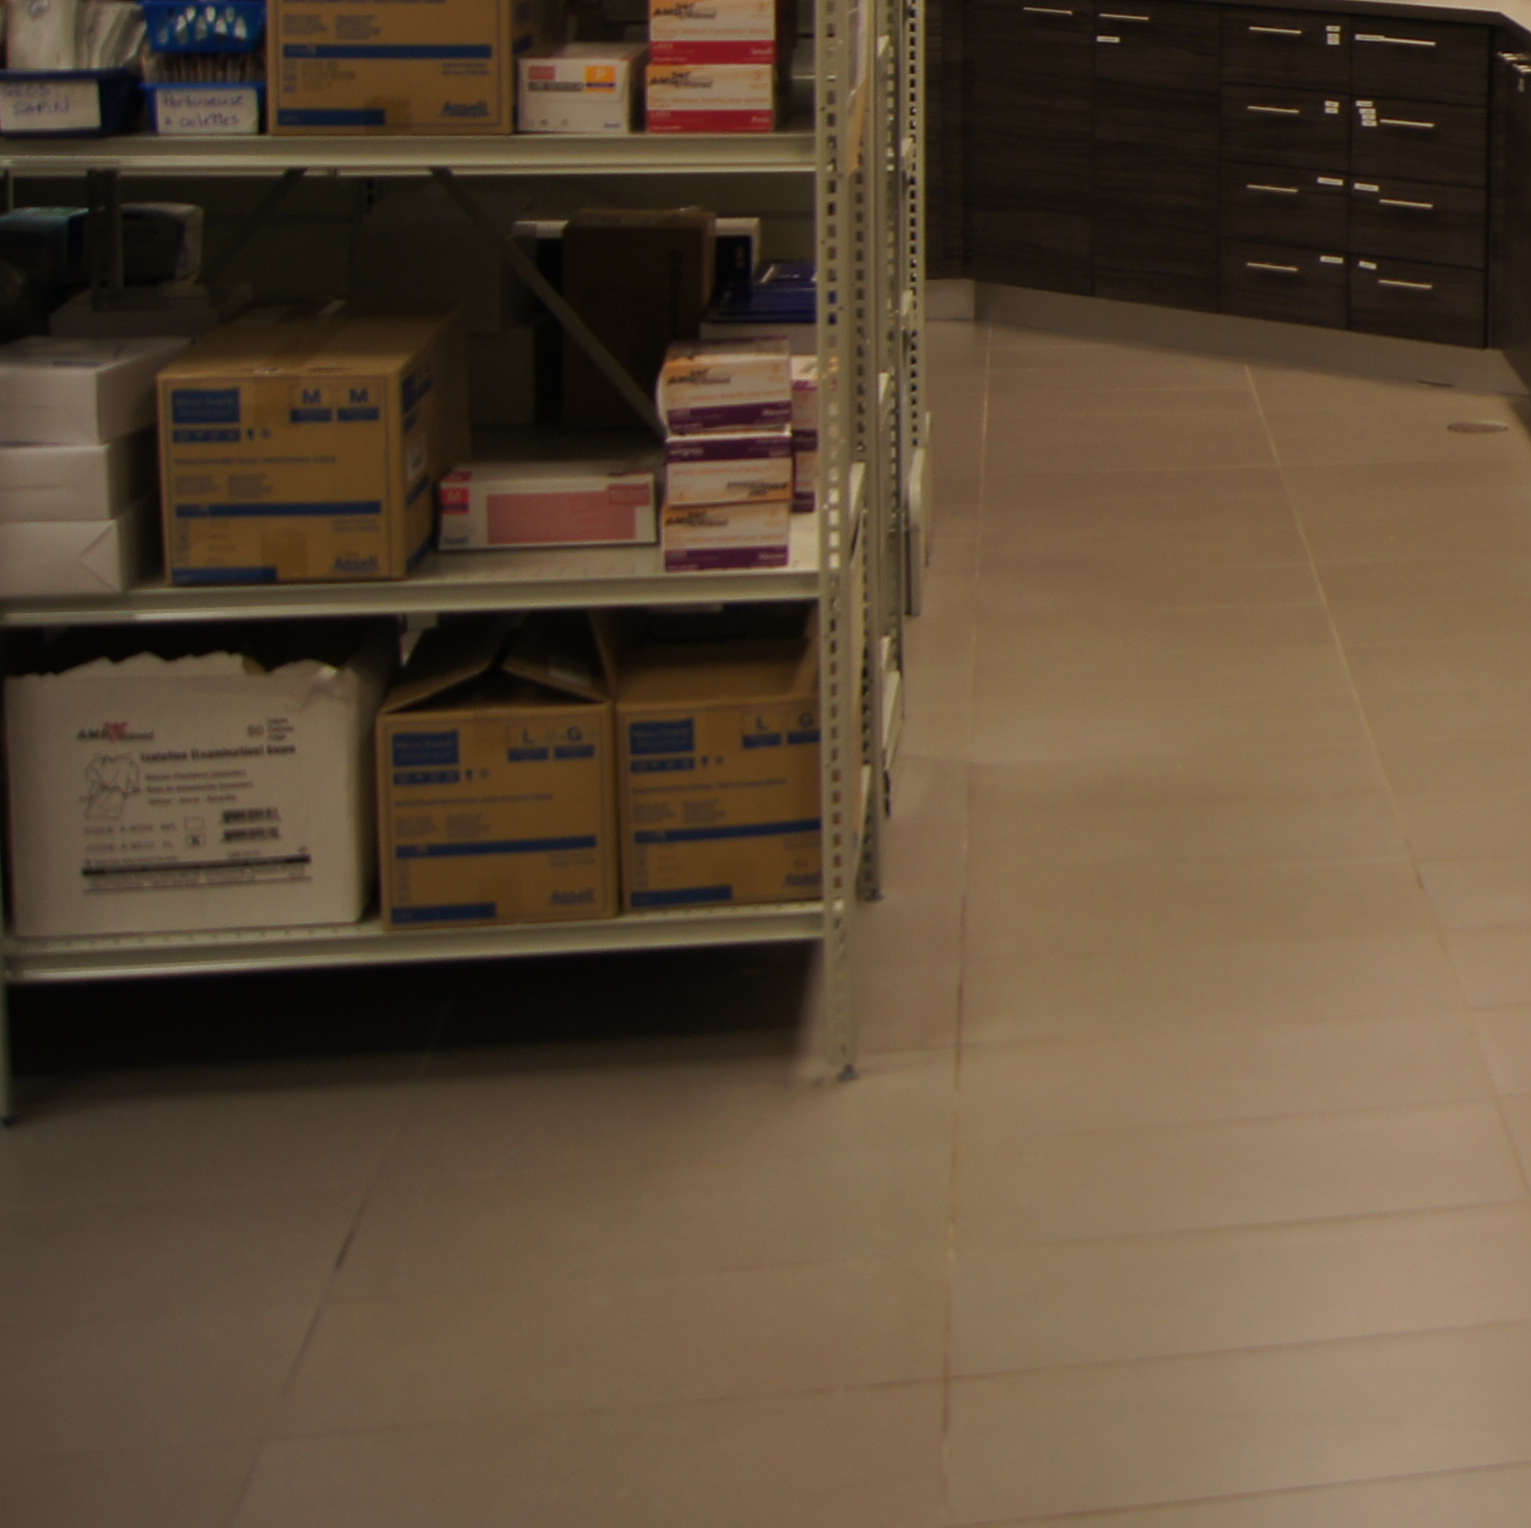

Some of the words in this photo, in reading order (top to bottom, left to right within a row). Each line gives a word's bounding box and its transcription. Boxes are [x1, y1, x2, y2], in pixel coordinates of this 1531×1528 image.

[302, 388, 321, 404] M
[350, 388, 368, 403] M
[756, 716, 768, 730] L
[798, 712, 815, 727] G
[523, 729, 535, 744] L
[567, 726, 582, 742] G
